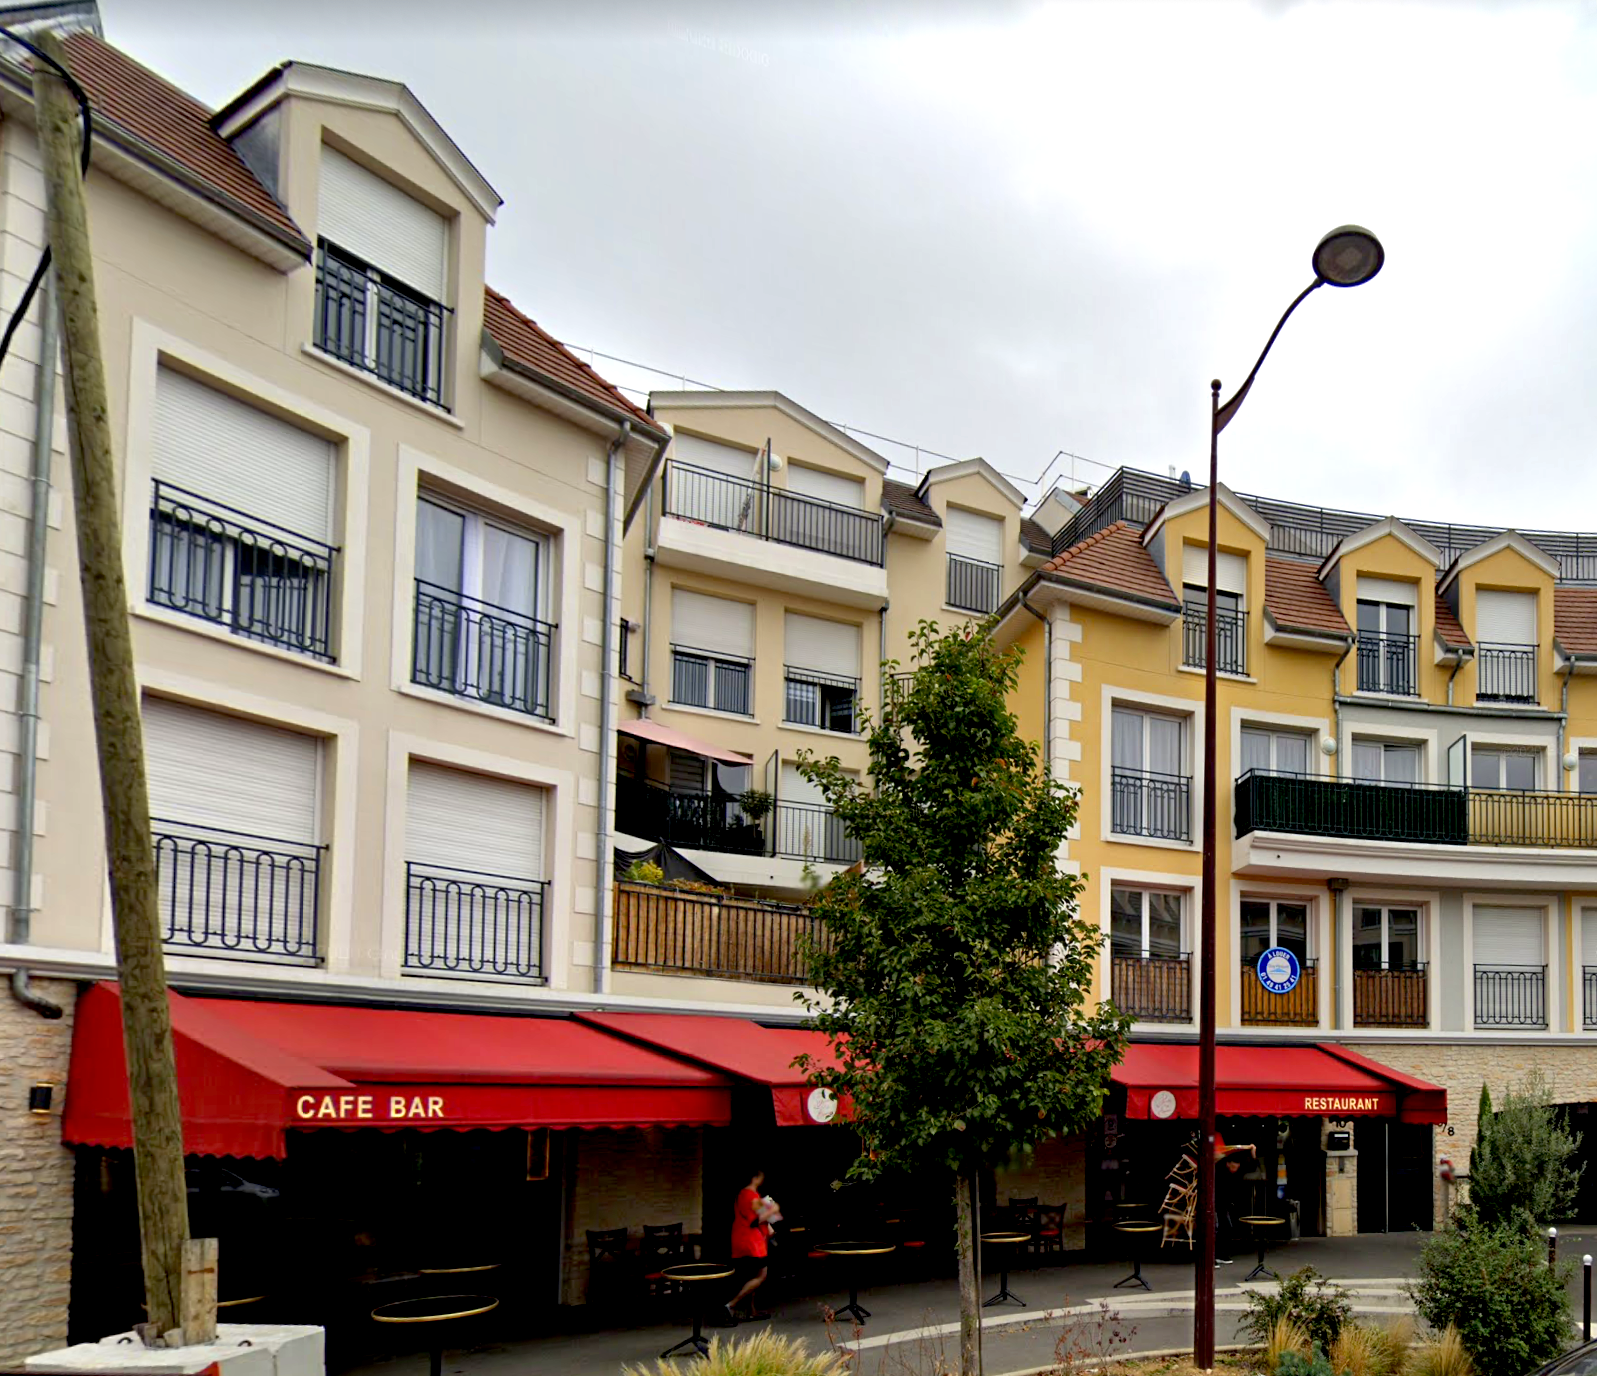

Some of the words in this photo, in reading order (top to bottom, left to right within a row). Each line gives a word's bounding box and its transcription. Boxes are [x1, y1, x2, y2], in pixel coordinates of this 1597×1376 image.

[1272, 950, 1290, 960] LOUER
[297, 1095, 373, 1119] CAFE
[390, 1096, 444, 1118] BAR
[1304, 1098, 1379, 1110] RESTAURANT
